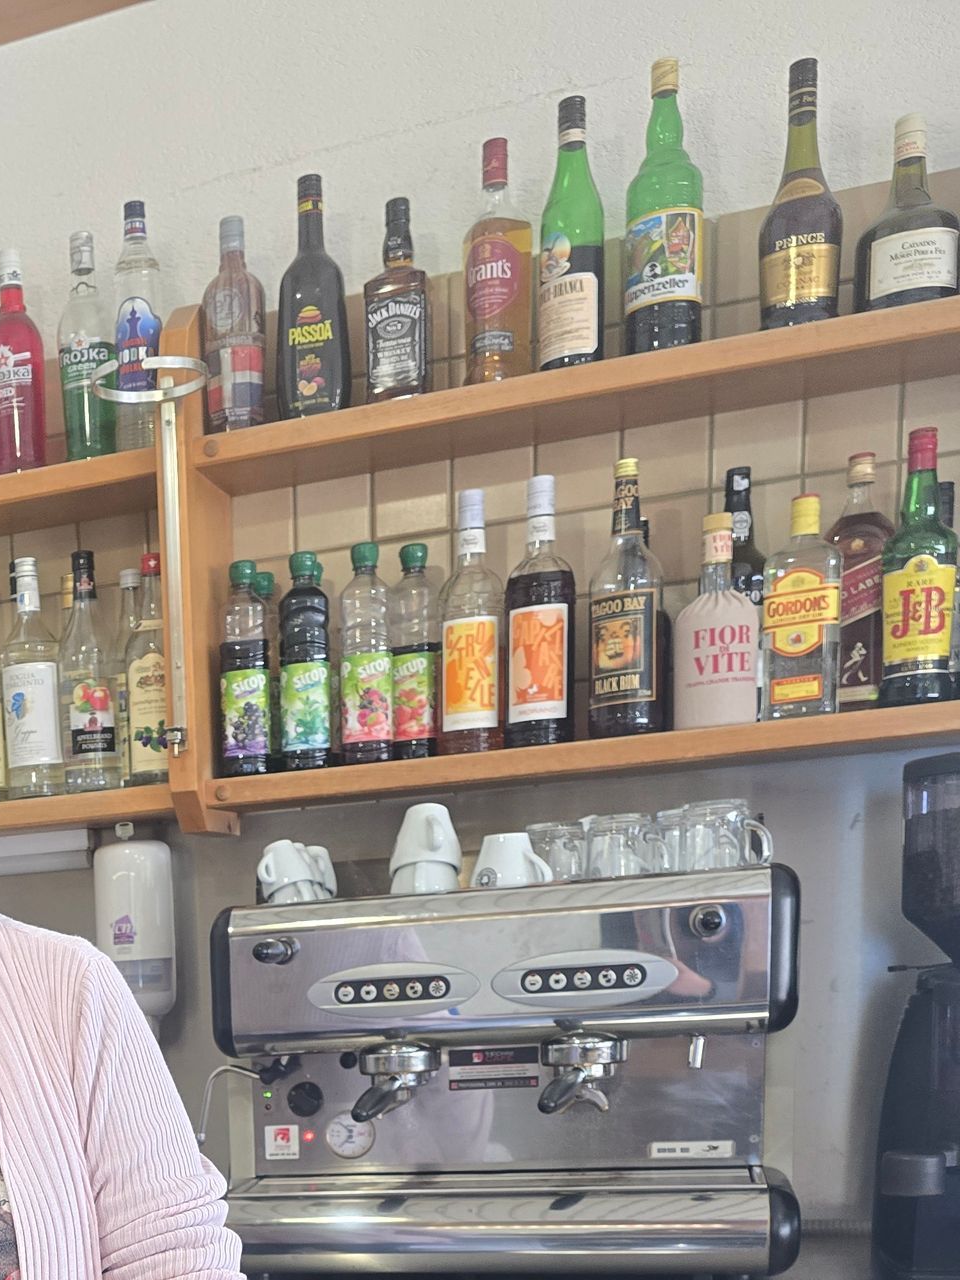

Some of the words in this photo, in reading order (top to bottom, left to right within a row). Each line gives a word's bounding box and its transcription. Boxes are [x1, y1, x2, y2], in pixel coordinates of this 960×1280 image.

[775, 232, 825, 251] PRINCE
[368, 307, 389, 328] JACK
[849, 575, 880, 595] LABE
[767, 595, 830, 618] GORDON'S
[693, 624, 751, 650] FIOR
[693, 651, 752, 676] VITE
[231, 672, 266, 696] sirop
[292, 666, 328, 690] sirop
